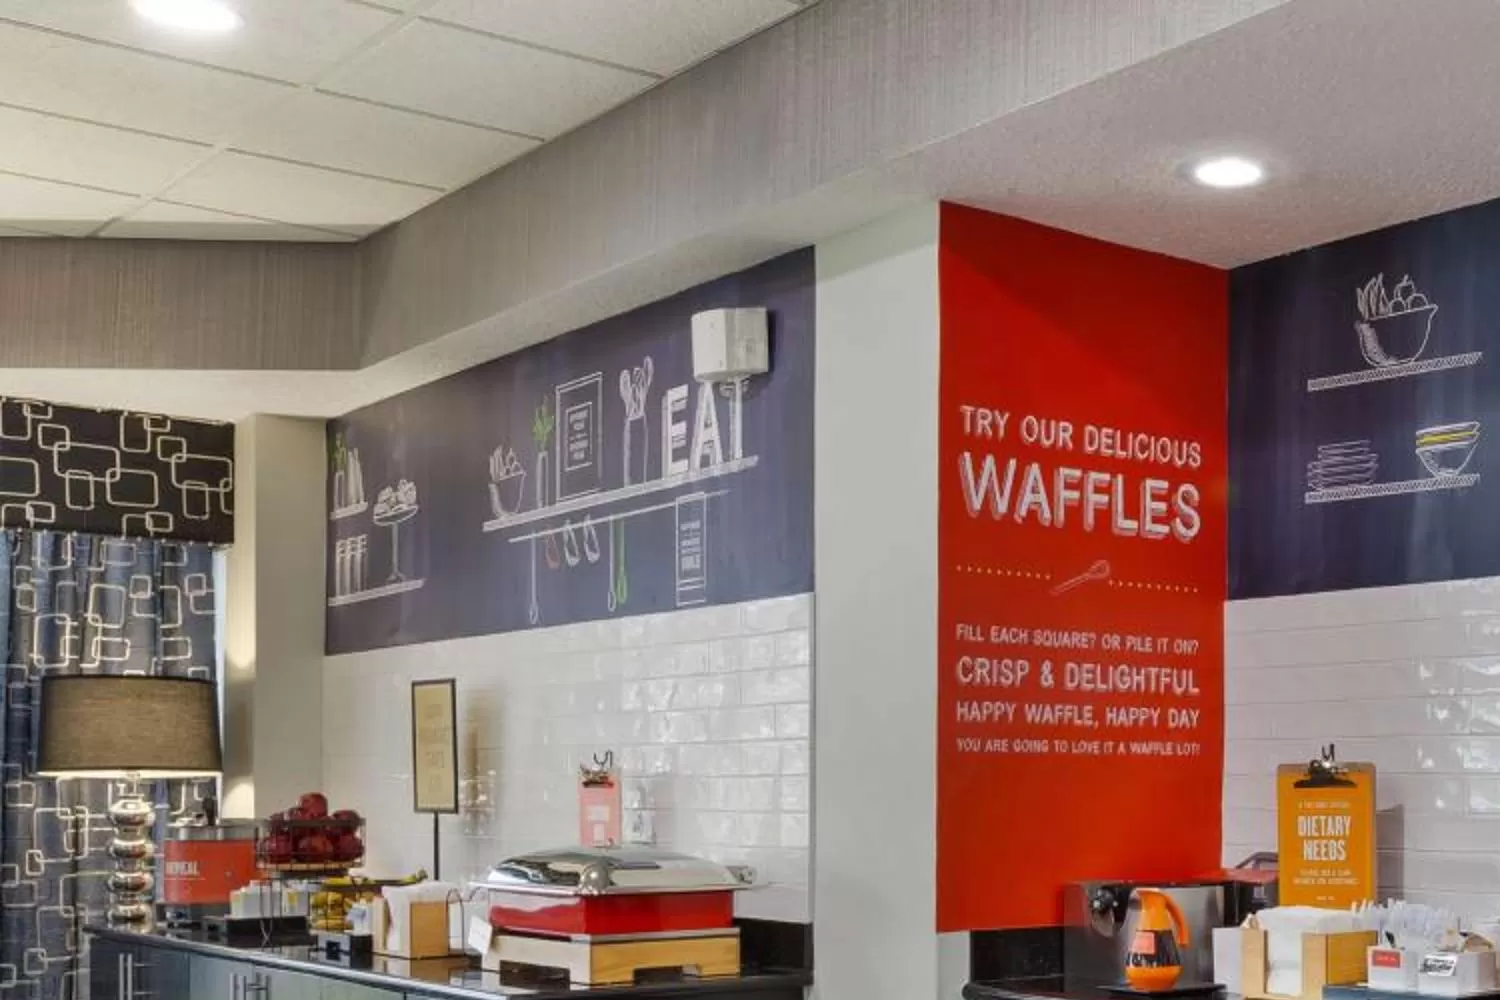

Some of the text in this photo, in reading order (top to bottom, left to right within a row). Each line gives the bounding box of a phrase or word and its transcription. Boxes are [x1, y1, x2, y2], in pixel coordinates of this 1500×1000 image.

[960, 405, 1201, 468] TRY OUR DELICIOUS
[959, 451, 1201, 544] WAFFLES
[956, 623, 1199, 656] FILL EACH SQUARE? OR PILE IT ON?
[956, 656, 1200, 695] CRISP & DELIGHTFUL
[956, 701, 1200, 729] HAPPY WAFFLE, HAPPY DAY
[956, 738, 981, 752] YOU
[984, 738, 1009, 753] ARE
[1013, 739, 1049, 753] GOING
[1054, 740, 1067, 753] TO
[1071, 741, 1099, 755] LOVE
[1104, 741, 1114, 754] IT
[1117, 742, 1127, 755] A
[1130, 742, 1173, 757] WAFFLE
[1297, 815, 1351, 837] DIETARY
[1303, 839, 1346, 861] NEEDS
